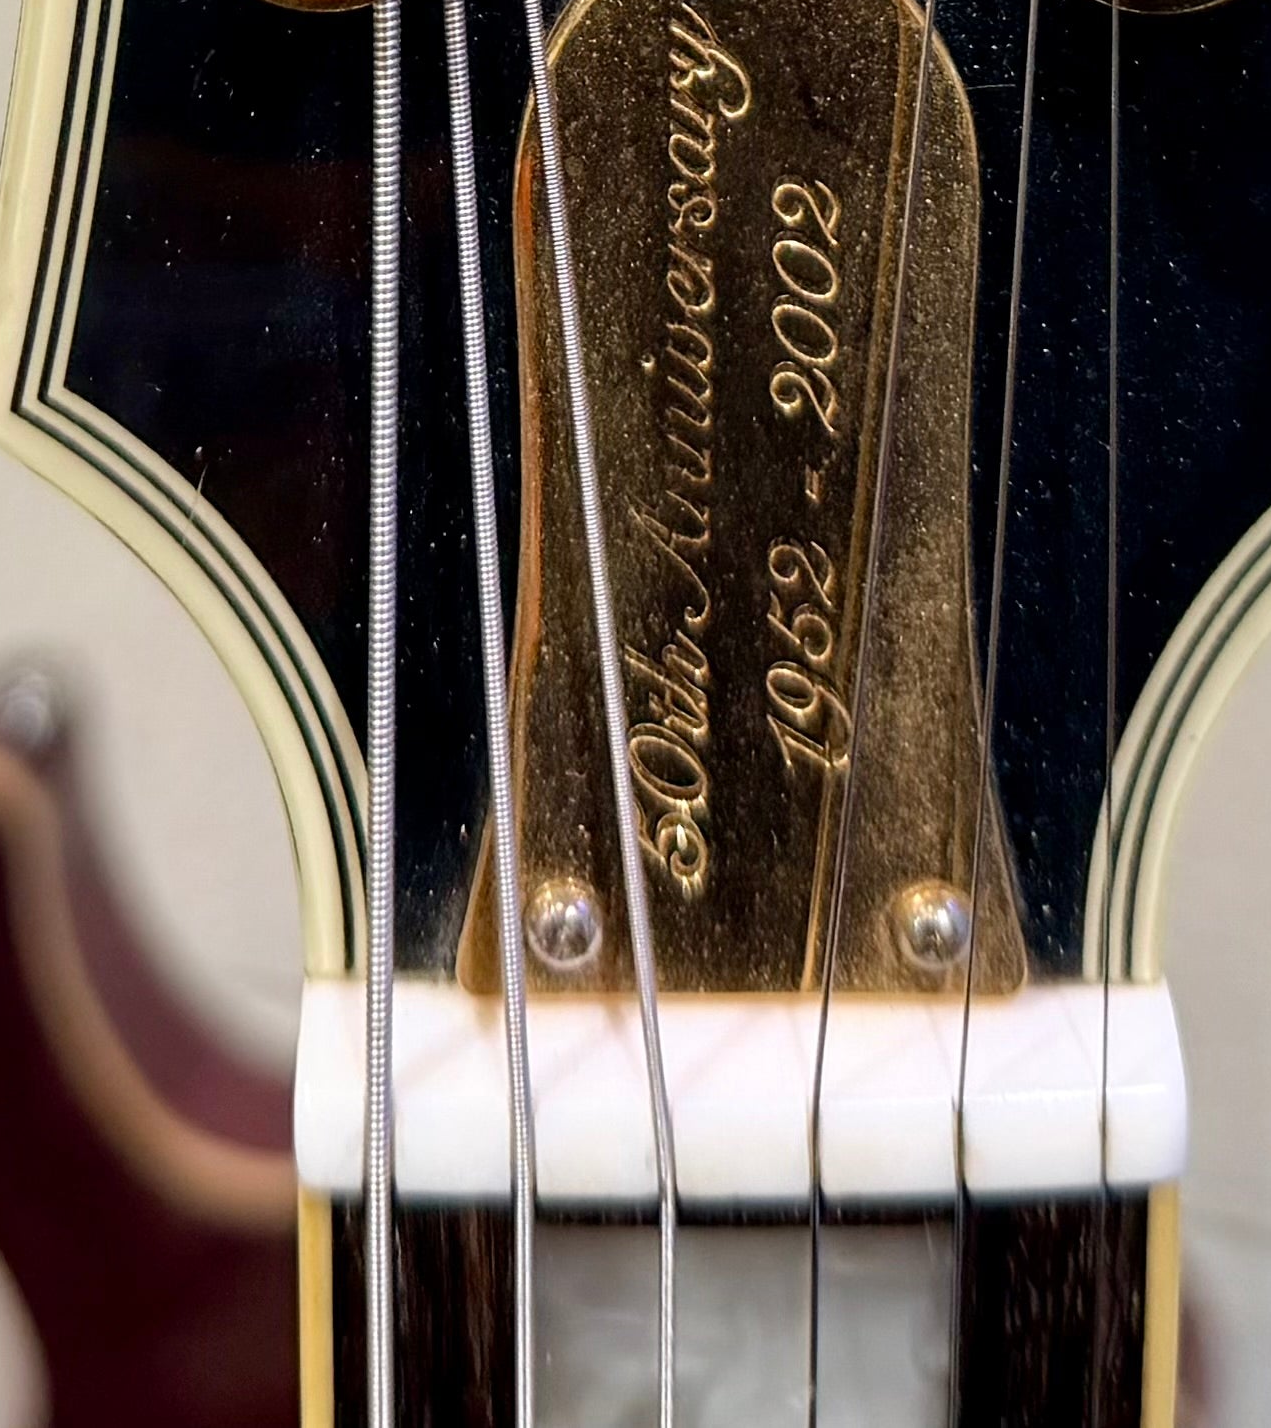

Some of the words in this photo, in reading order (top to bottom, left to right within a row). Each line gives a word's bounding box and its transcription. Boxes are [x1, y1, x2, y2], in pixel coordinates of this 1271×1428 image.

[629, 1, 752, 625] Anniversary
[769, 176, 841, 433] 2002
[624, 628, 711, 898] 50th
[766, 539, 852, 771] 1952
